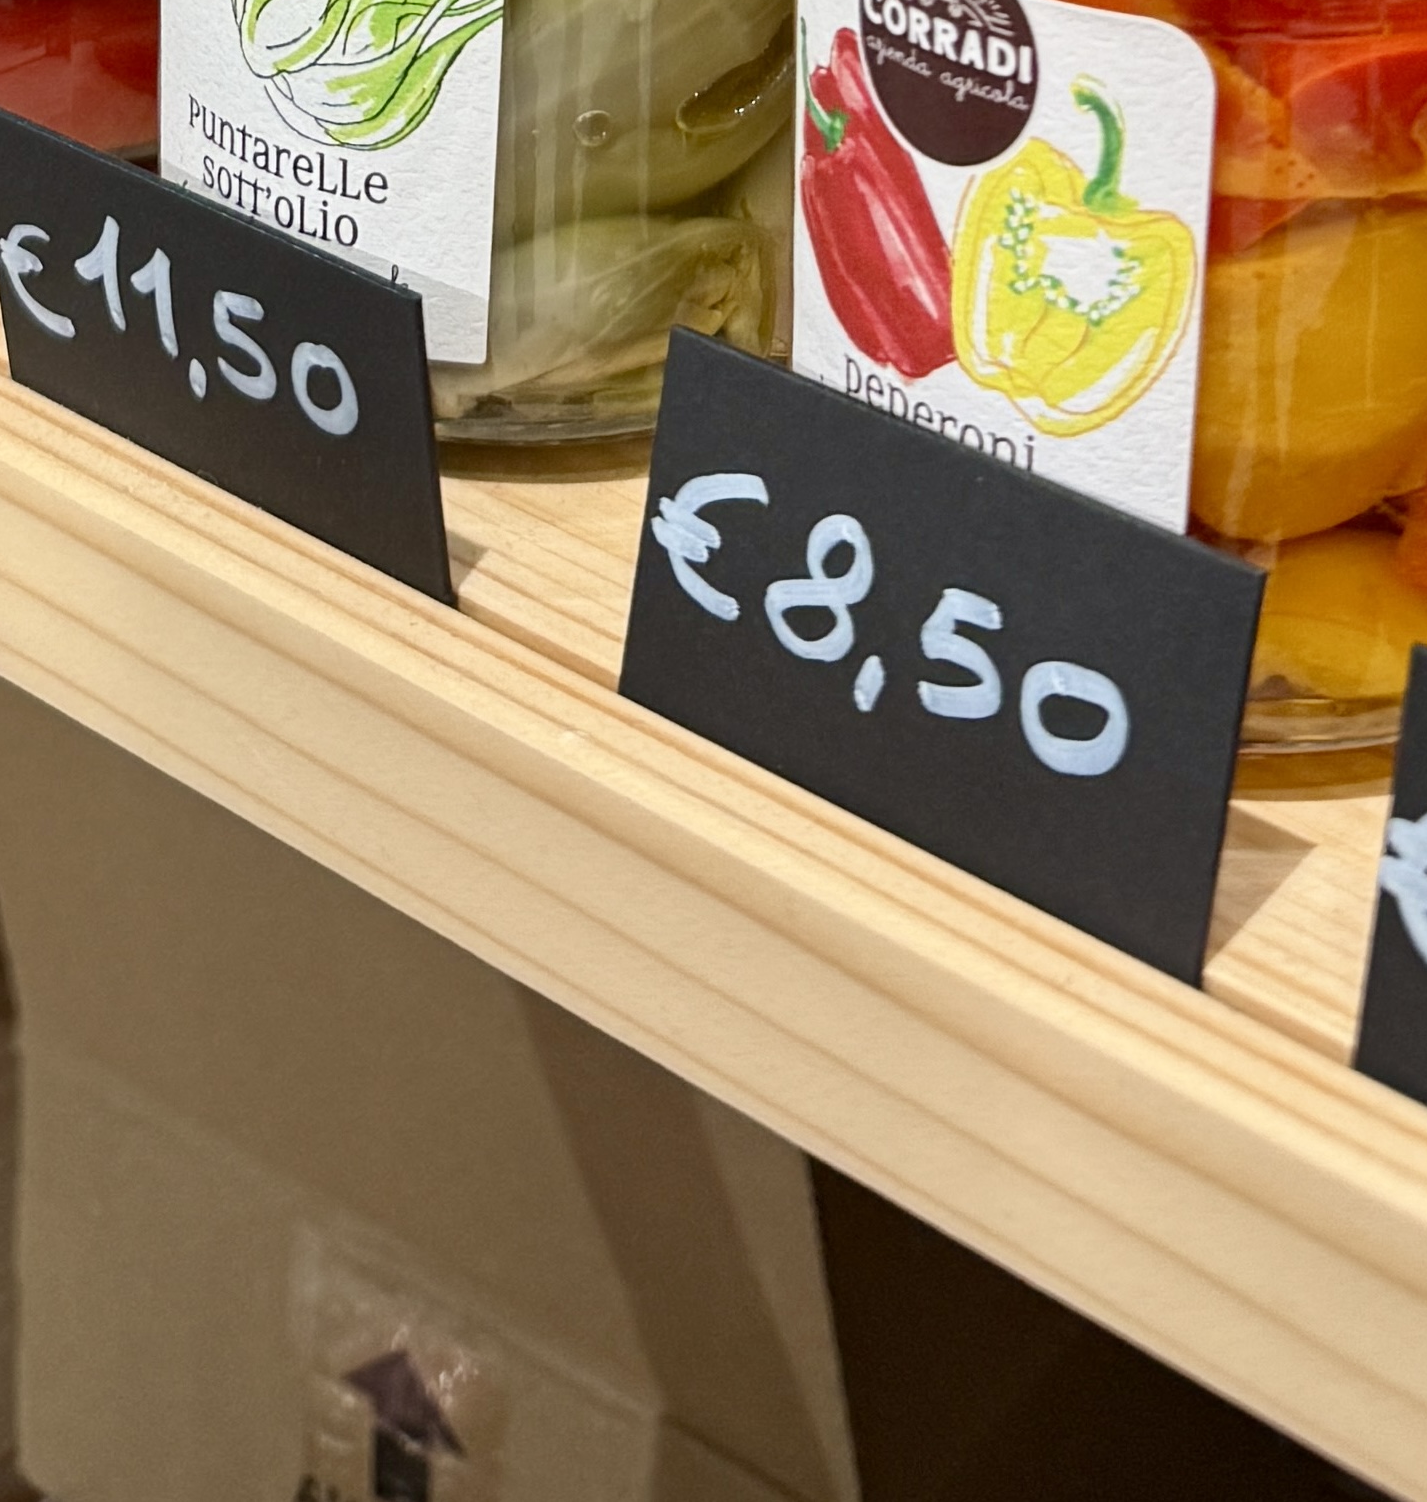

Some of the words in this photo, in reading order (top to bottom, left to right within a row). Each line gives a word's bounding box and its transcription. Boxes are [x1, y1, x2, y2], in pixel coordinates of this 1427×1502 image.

[865, 34, 933, 79] azienda
[938, 67, 1031, 110] agricola
[650, 472, 1131, 776] €8,50
